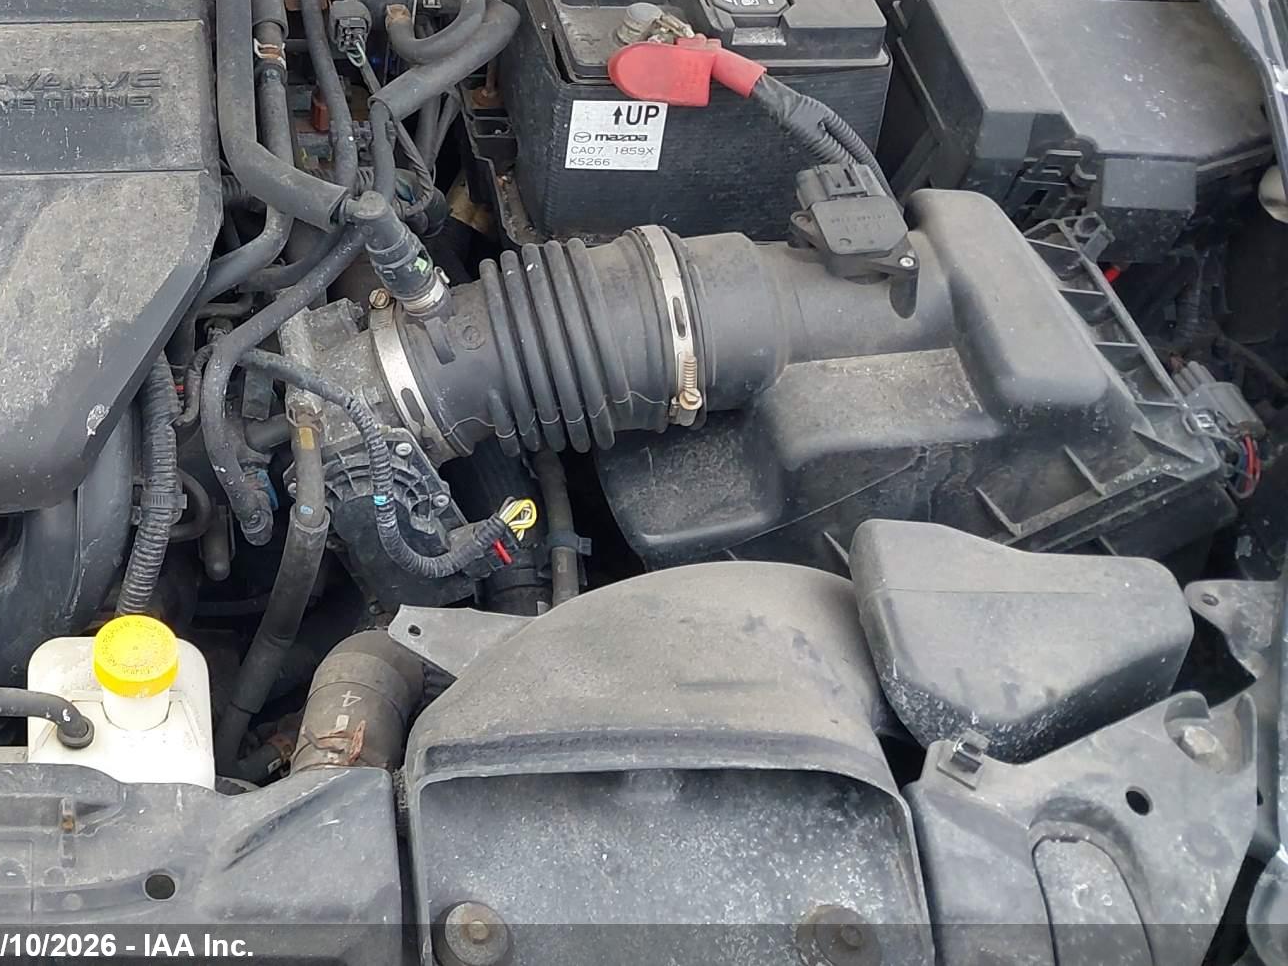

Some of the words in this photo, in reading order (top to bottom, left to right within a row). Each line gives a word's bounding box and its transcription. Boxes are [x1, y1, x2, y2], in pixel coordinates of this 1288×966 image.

[47, 93, 153, 112] TIMING
[626, 105, 660, 126] UP
[594, 133, 648, 142] mazda
[570, 146, 604, 155] CA07
[614, 146, 655, 156] 1859X
[569, 157, 611, 166] K5266
